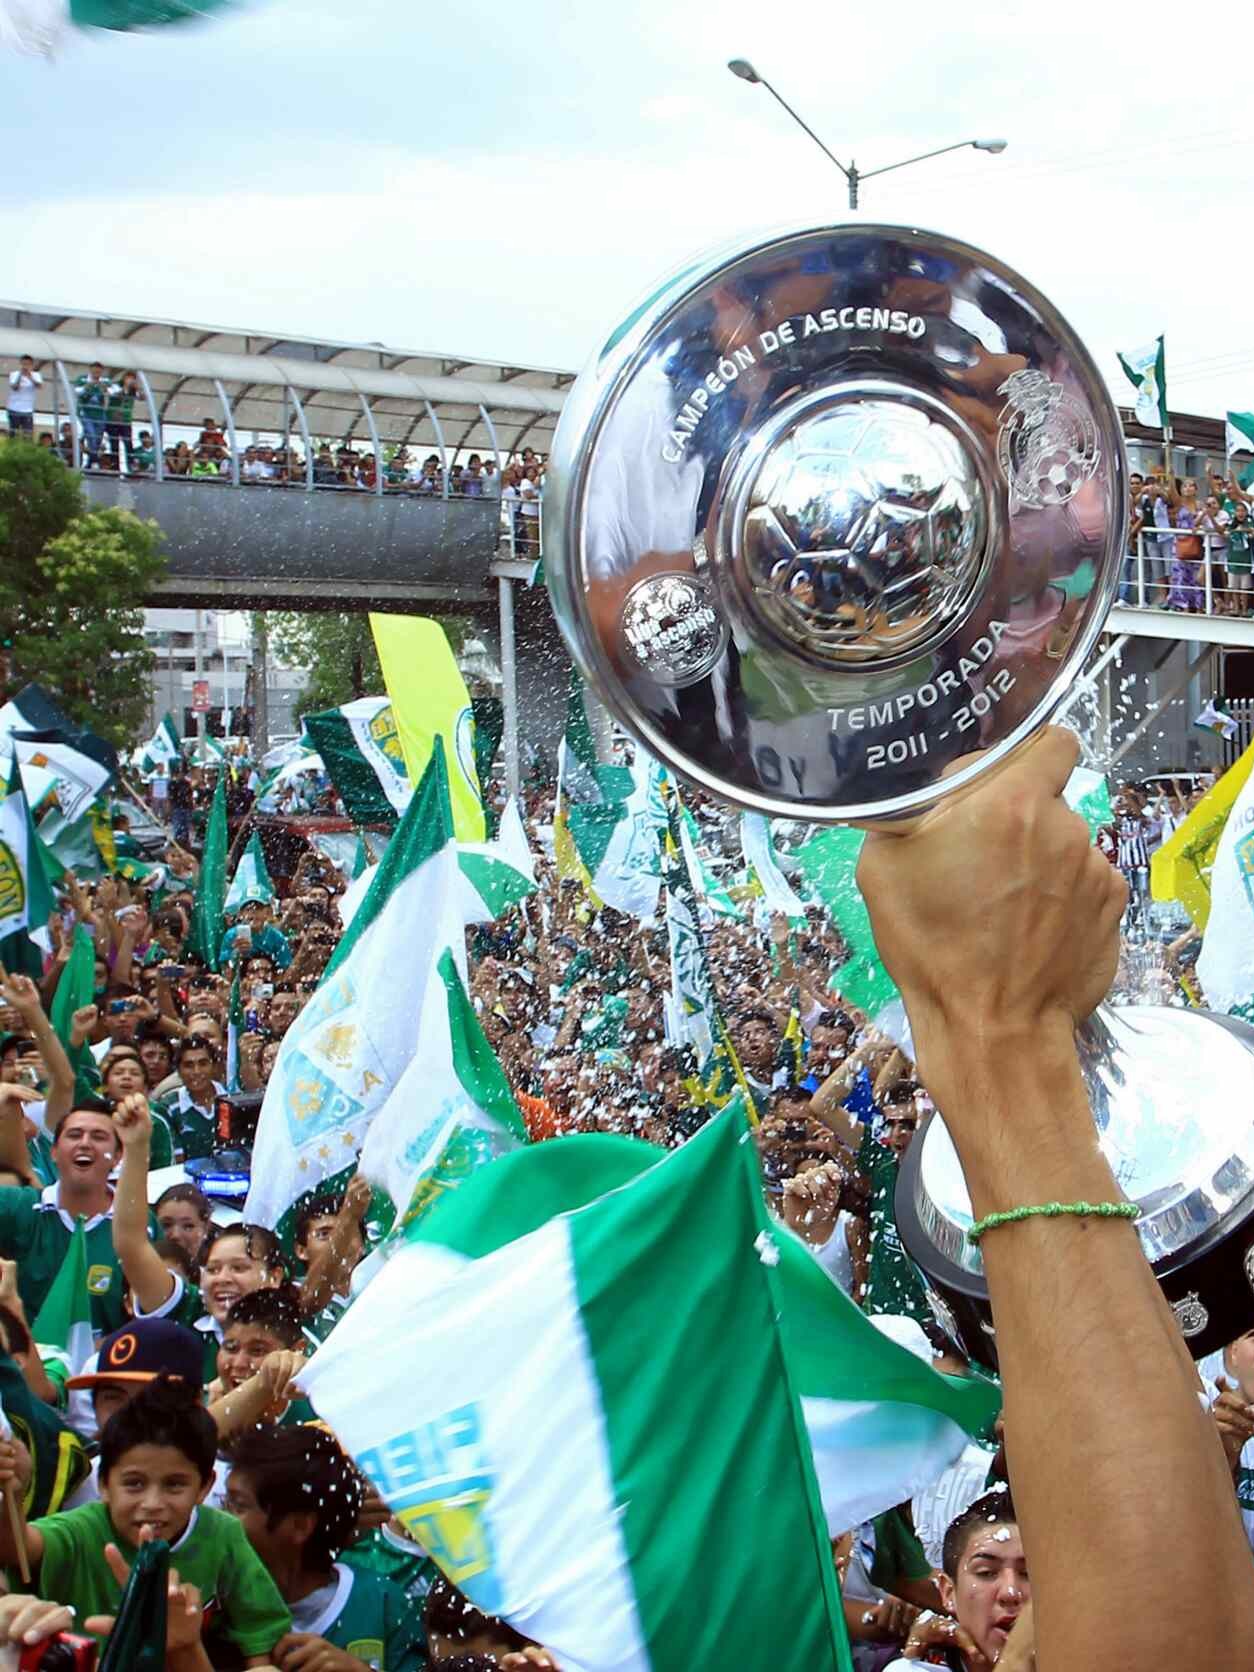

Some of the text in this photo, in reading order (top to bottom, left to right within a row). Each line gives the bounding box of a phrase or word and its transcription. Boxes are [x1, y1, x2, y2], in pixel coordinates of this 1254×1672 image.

[662, 307, 926, 463] CAMPEÓN DE ASCENSO
[827, 620, 1010, 730] TEMPORADA
[867, 732, 928, 770] 2011
[952, 669, 1017, 733] 2012
